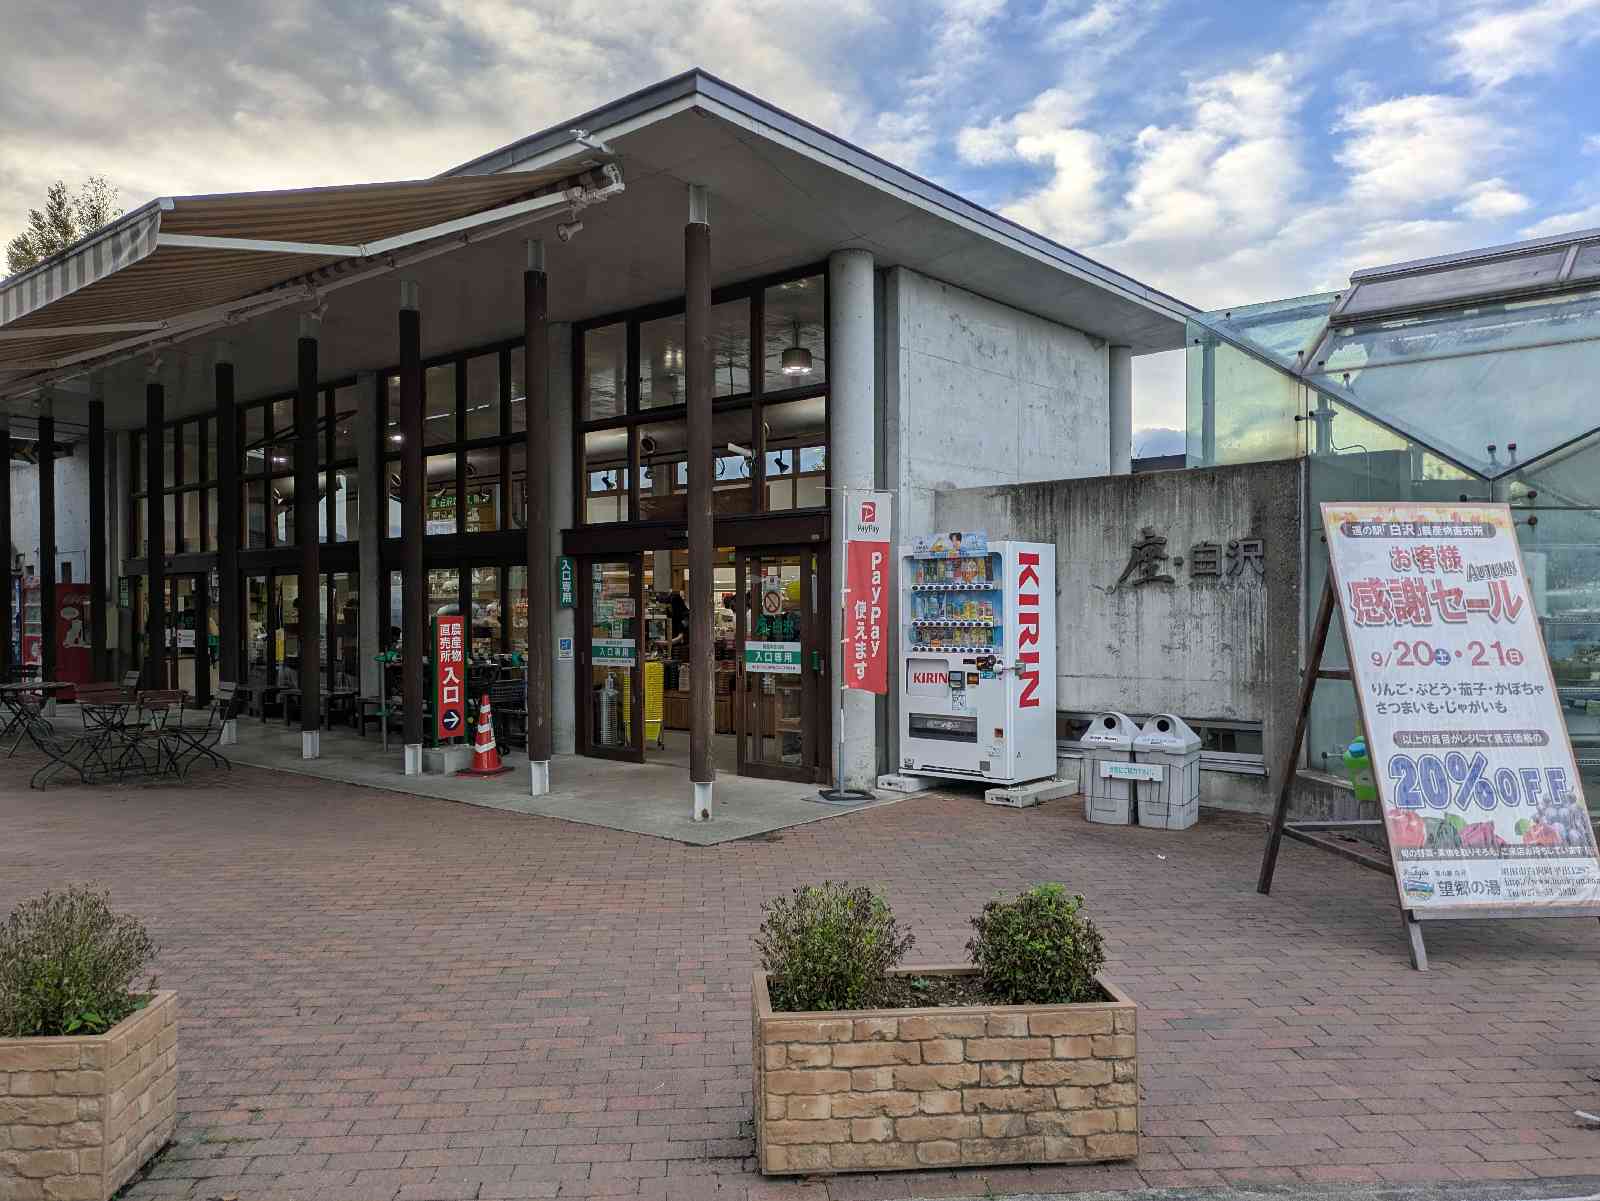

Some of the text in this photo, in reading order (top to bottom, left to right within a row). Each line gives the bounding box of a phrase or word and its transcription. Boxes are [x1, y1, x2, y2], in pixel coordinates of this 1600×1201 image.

[857, 524, 880, 535] PayPay
[1390, 545, 1464, 572] お客様
[870, 551, 882, 657] PayPay
[1349, 577, 1524, 626] 感謝セール
[853, 599, 868, 680] 使えます
[1018, 551, 1041, 709] KIRIN
[755, 651, 793, 664] 入口専用
[442, 667, 460, 704] 入口
[913, 672, 948, 685] KIRIN
[1376, 701, 1508, 715] さつまいも・じゃがいも
[1437, 879, 1501, 898] 望郷の湯
